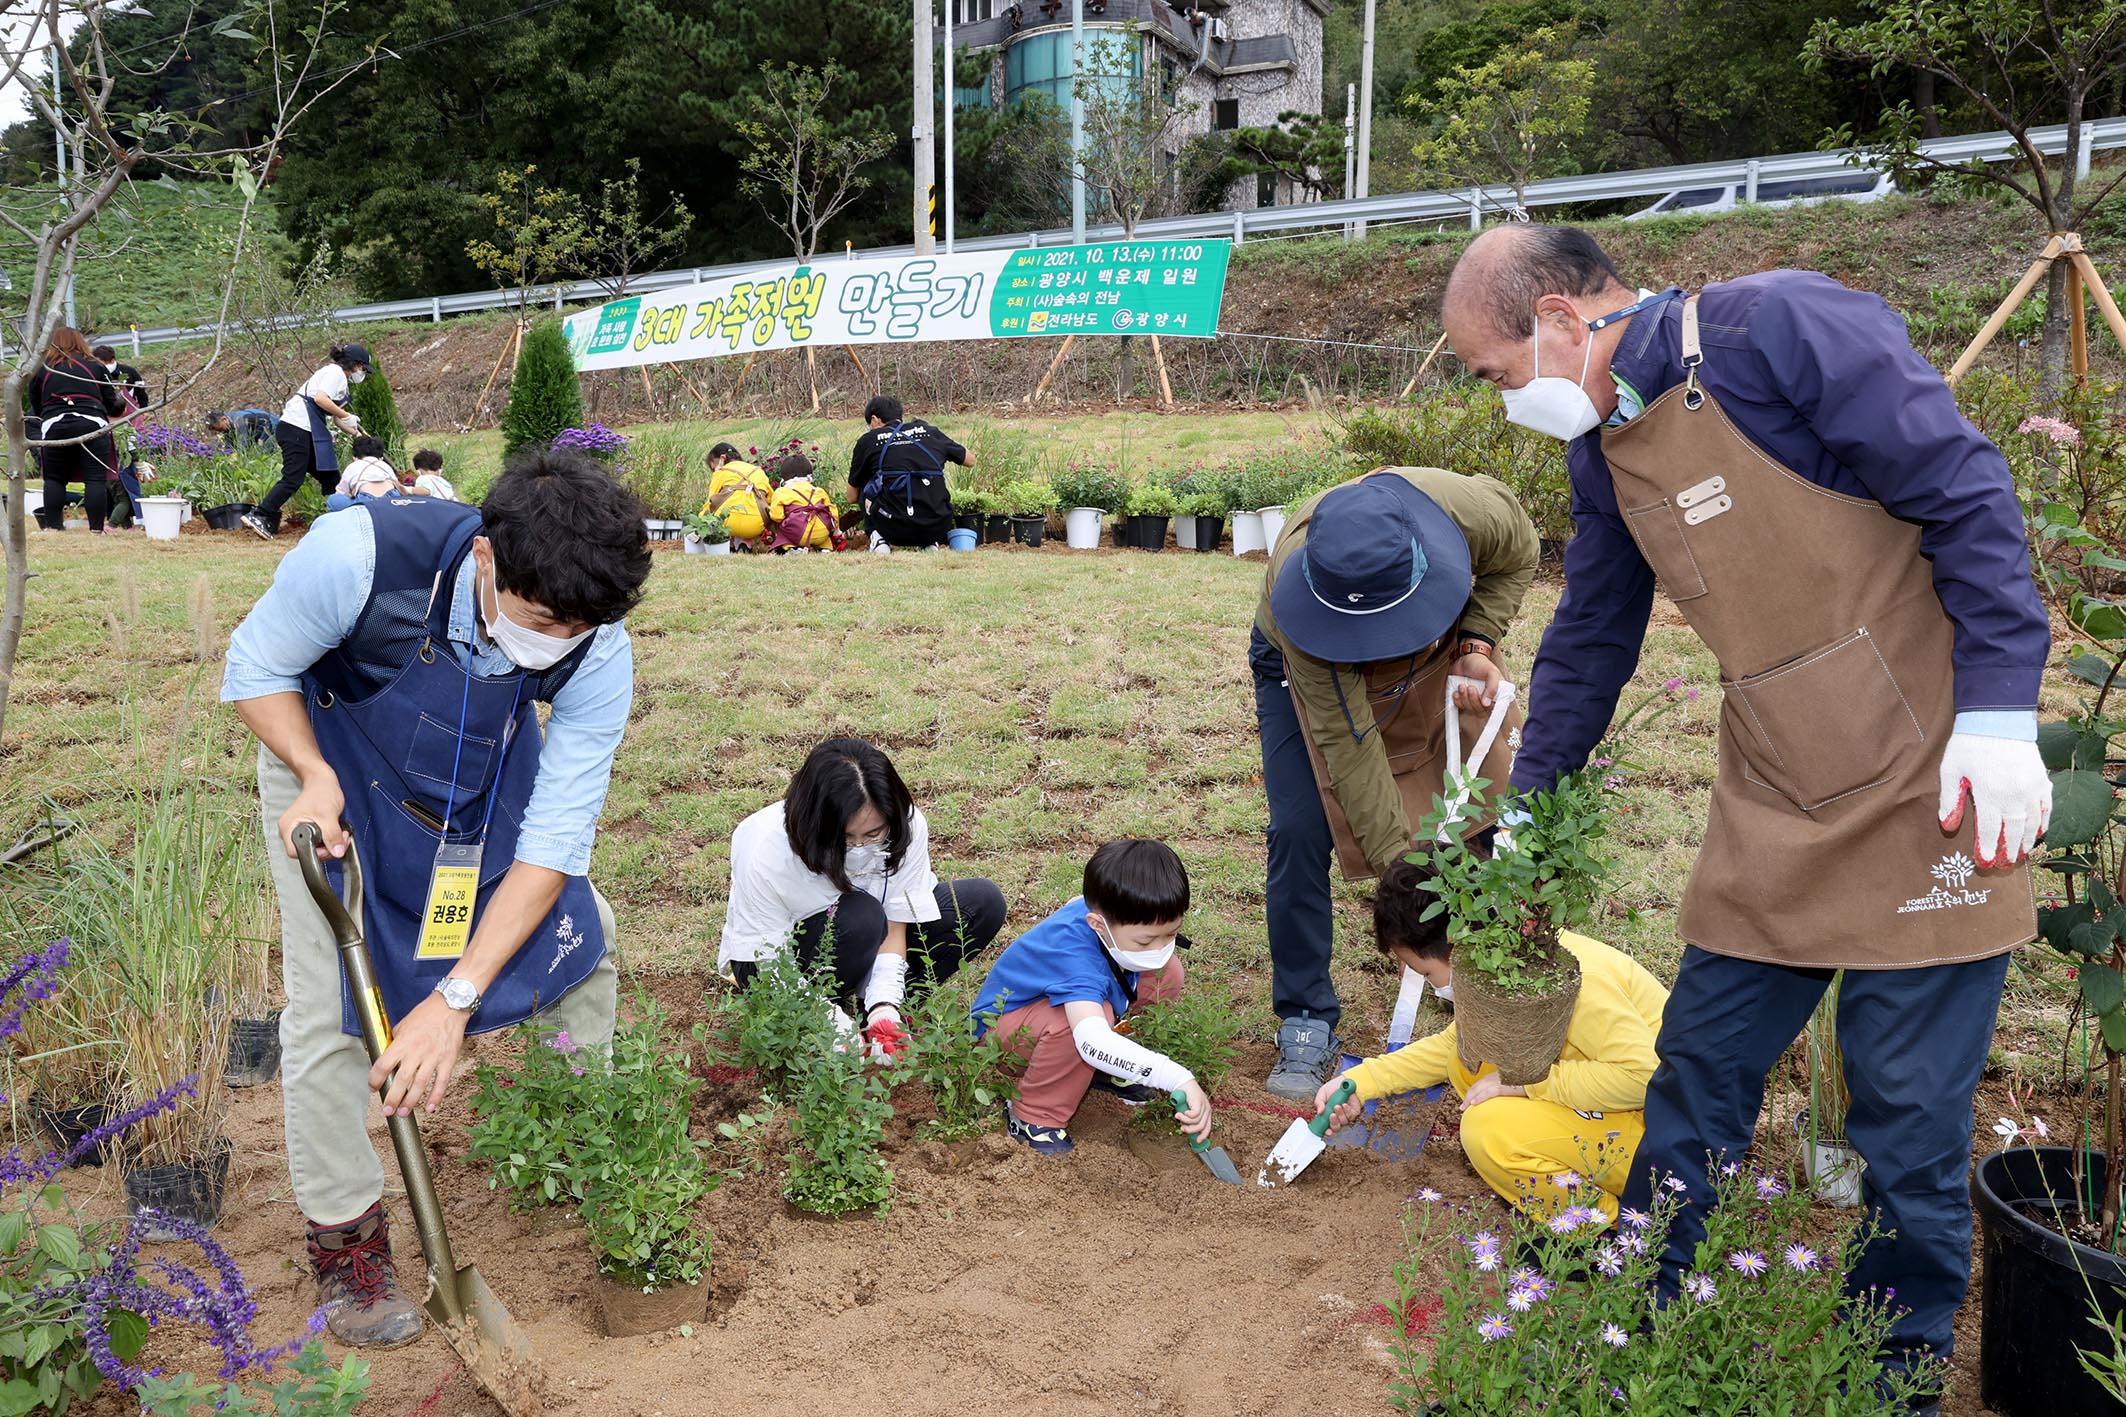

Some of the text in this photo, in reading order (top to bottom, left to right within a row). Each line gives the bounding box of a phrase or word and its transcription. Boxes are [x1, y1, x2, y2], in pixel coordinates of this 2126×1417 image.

[1044, 251, 1078, 267] 2021.
[1086, 248, 1104, 264] 10.
[1161, 245, 1203, 261] 11:00
[1039, 270, 1088, 289] 광양시
[1098, 268, 1151, 285] 백운제
[1162, 268, 1198, 285] 일원
[634, 259, 985, 352] 3대 가족정원 만들기
[1094, 291, 1121, 305] 전남
[1048, 312, 1098, 328] 전라남도
[1136, 312, 1188, 328] 광양시
[442, 890, 466, 901] No.28
[1906, 896, 1935, 907] FOREST
[432, 904, 469, 925] 권용호
[1896, 903, 1936, 914] JEONNAM
[1080, 1041, 1097, 1058] NEW
[1097, 1051, 1136, 1073] BALANCE
